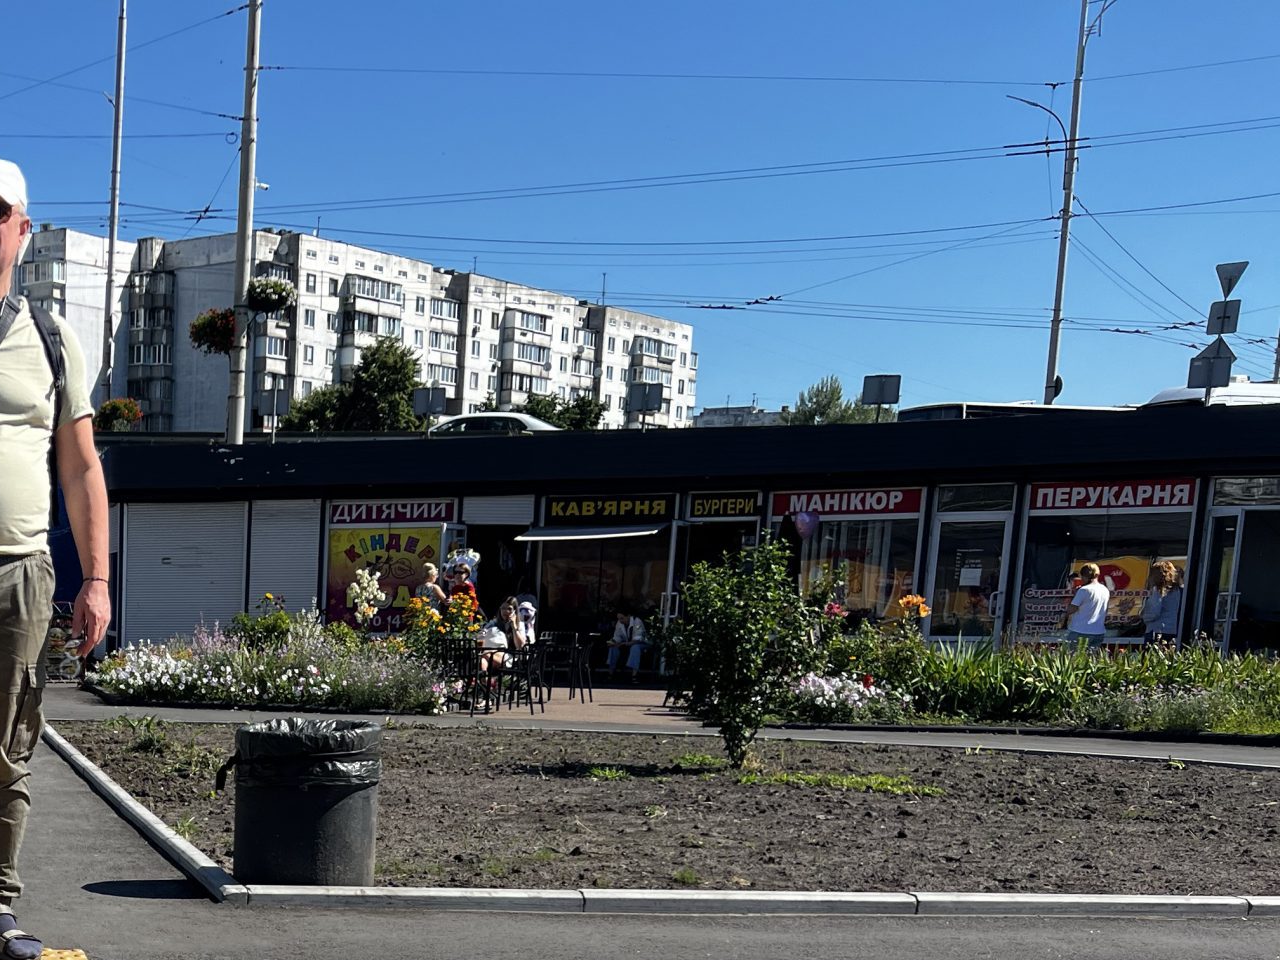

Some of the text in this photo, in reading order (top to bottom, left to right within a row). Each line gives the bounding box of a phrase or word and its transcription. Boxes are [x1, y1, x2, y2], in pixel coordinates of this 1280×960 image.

[694, 498, 754, 515] БУРГЕРИ
[789, 491, 904, 513] МАНІКЮР
[1036, 484, 1190, 508] ПЕРУКАРНЯ
[551, 500, 666, 516] КАВ'ЯРНЯ
[344, 534, 435, 563] КІНДЕР
